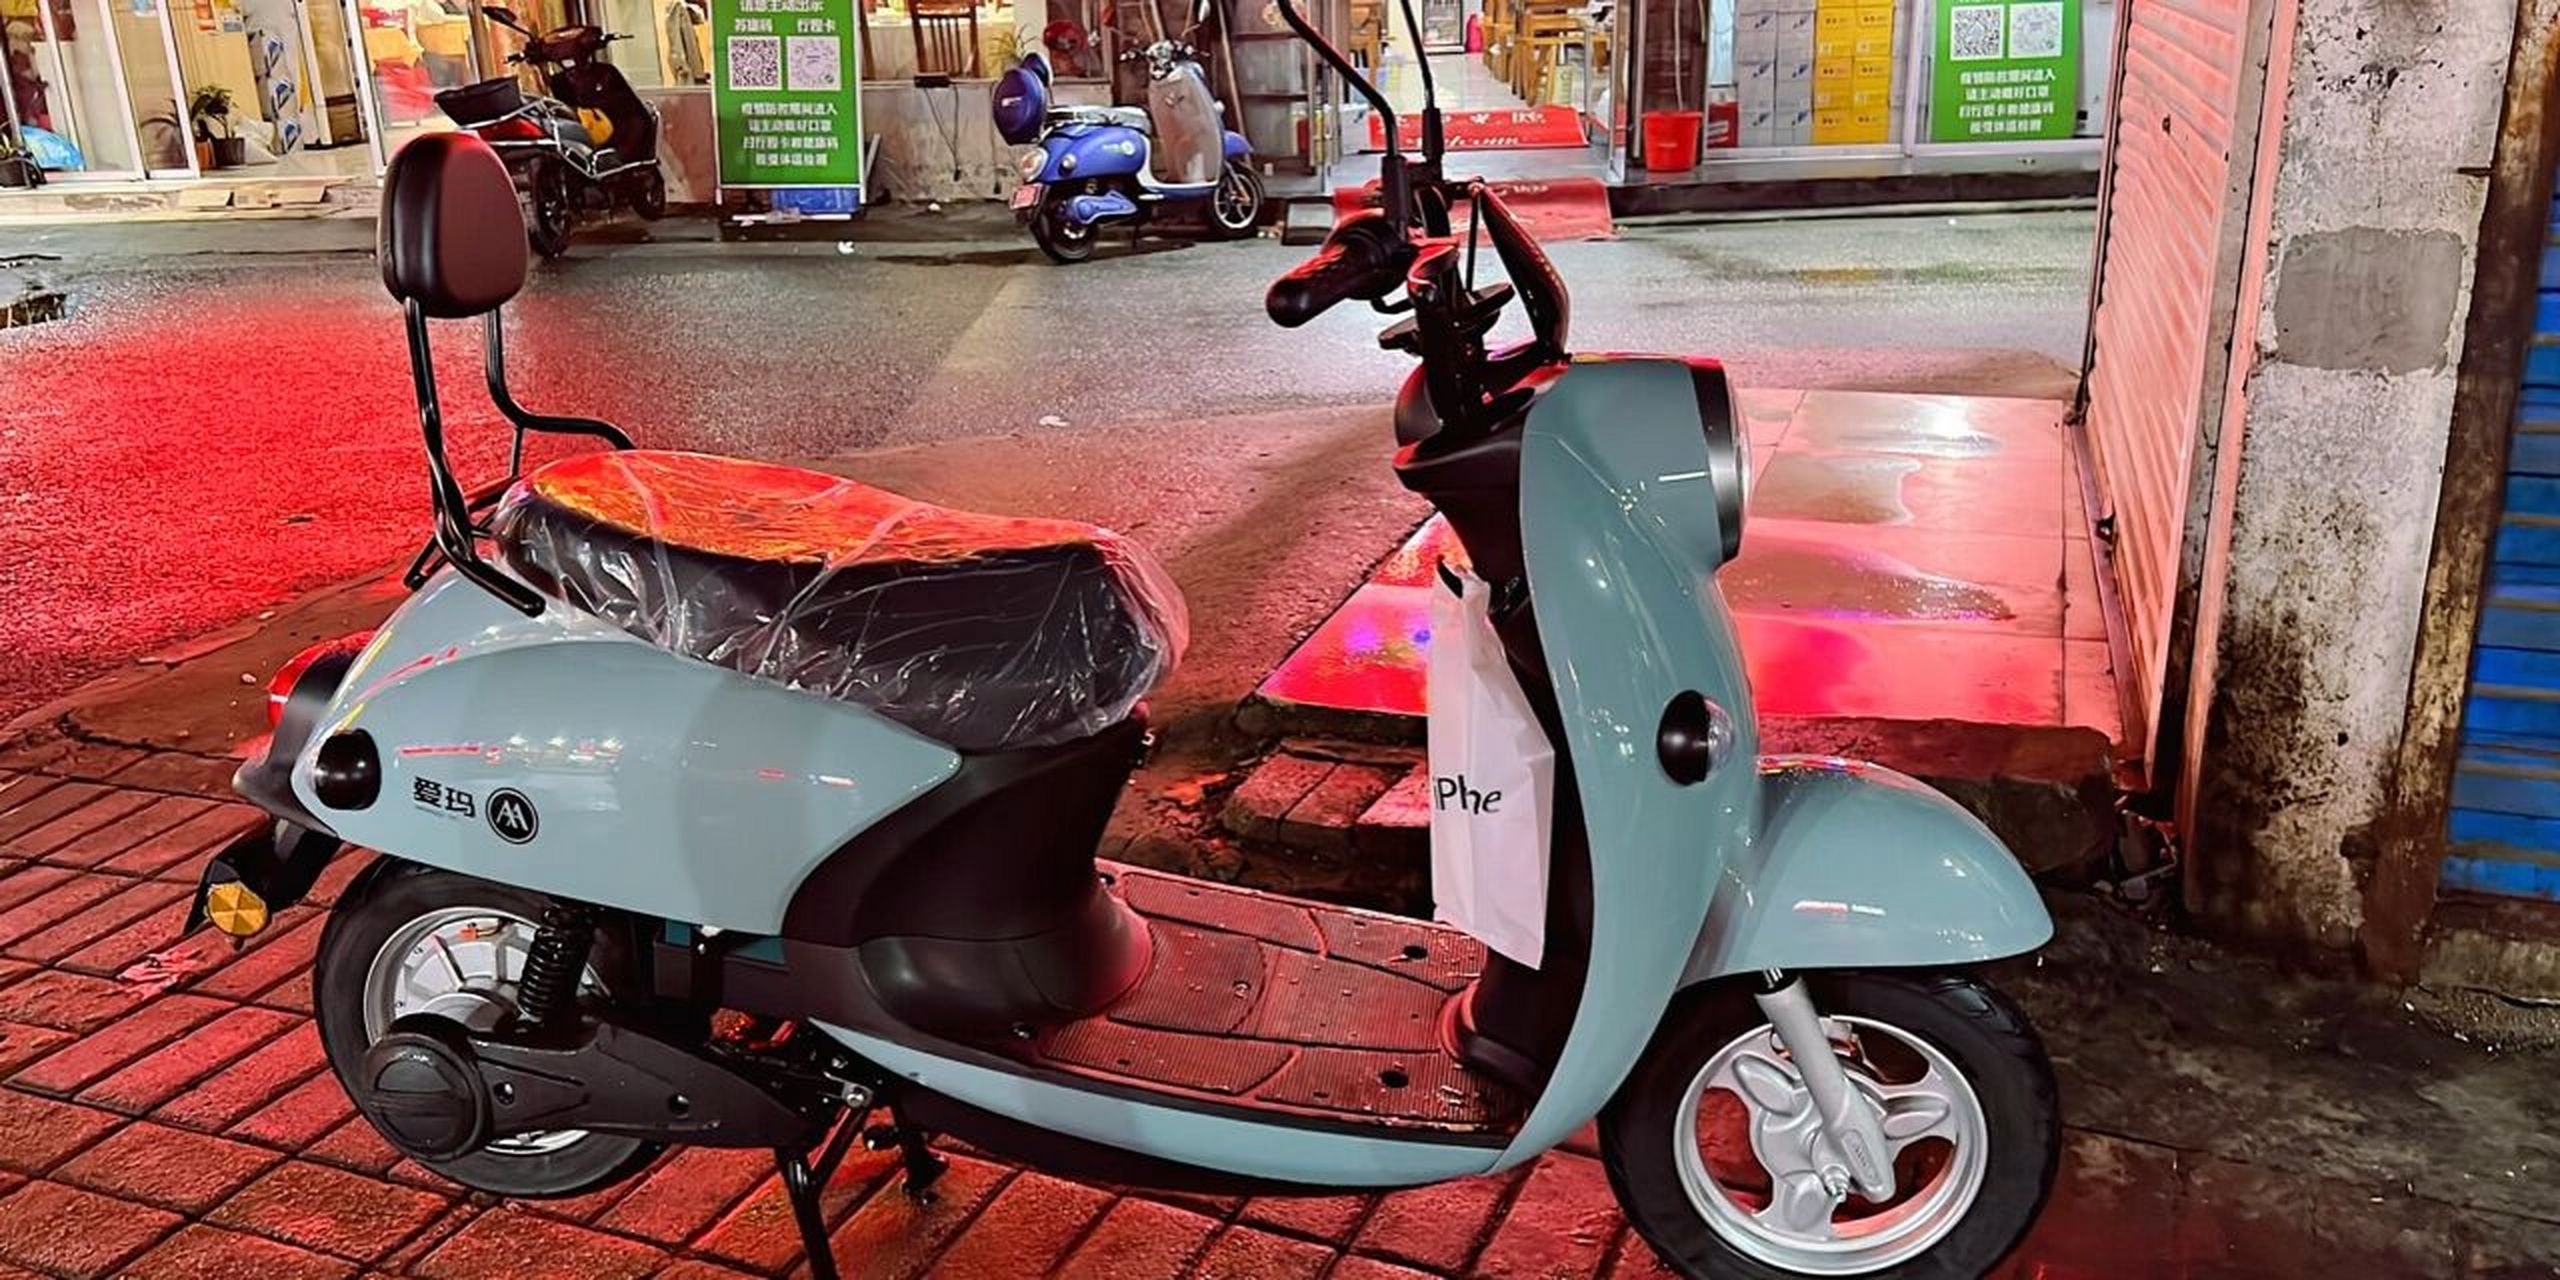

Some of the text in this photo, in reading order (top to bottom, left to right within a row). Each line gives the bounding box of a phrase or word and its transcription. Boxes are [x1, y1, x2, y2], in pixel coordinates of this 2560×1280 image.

[797, 18, 836, 32] 行程卡
[413, 776, 475, 818] 爱玛
